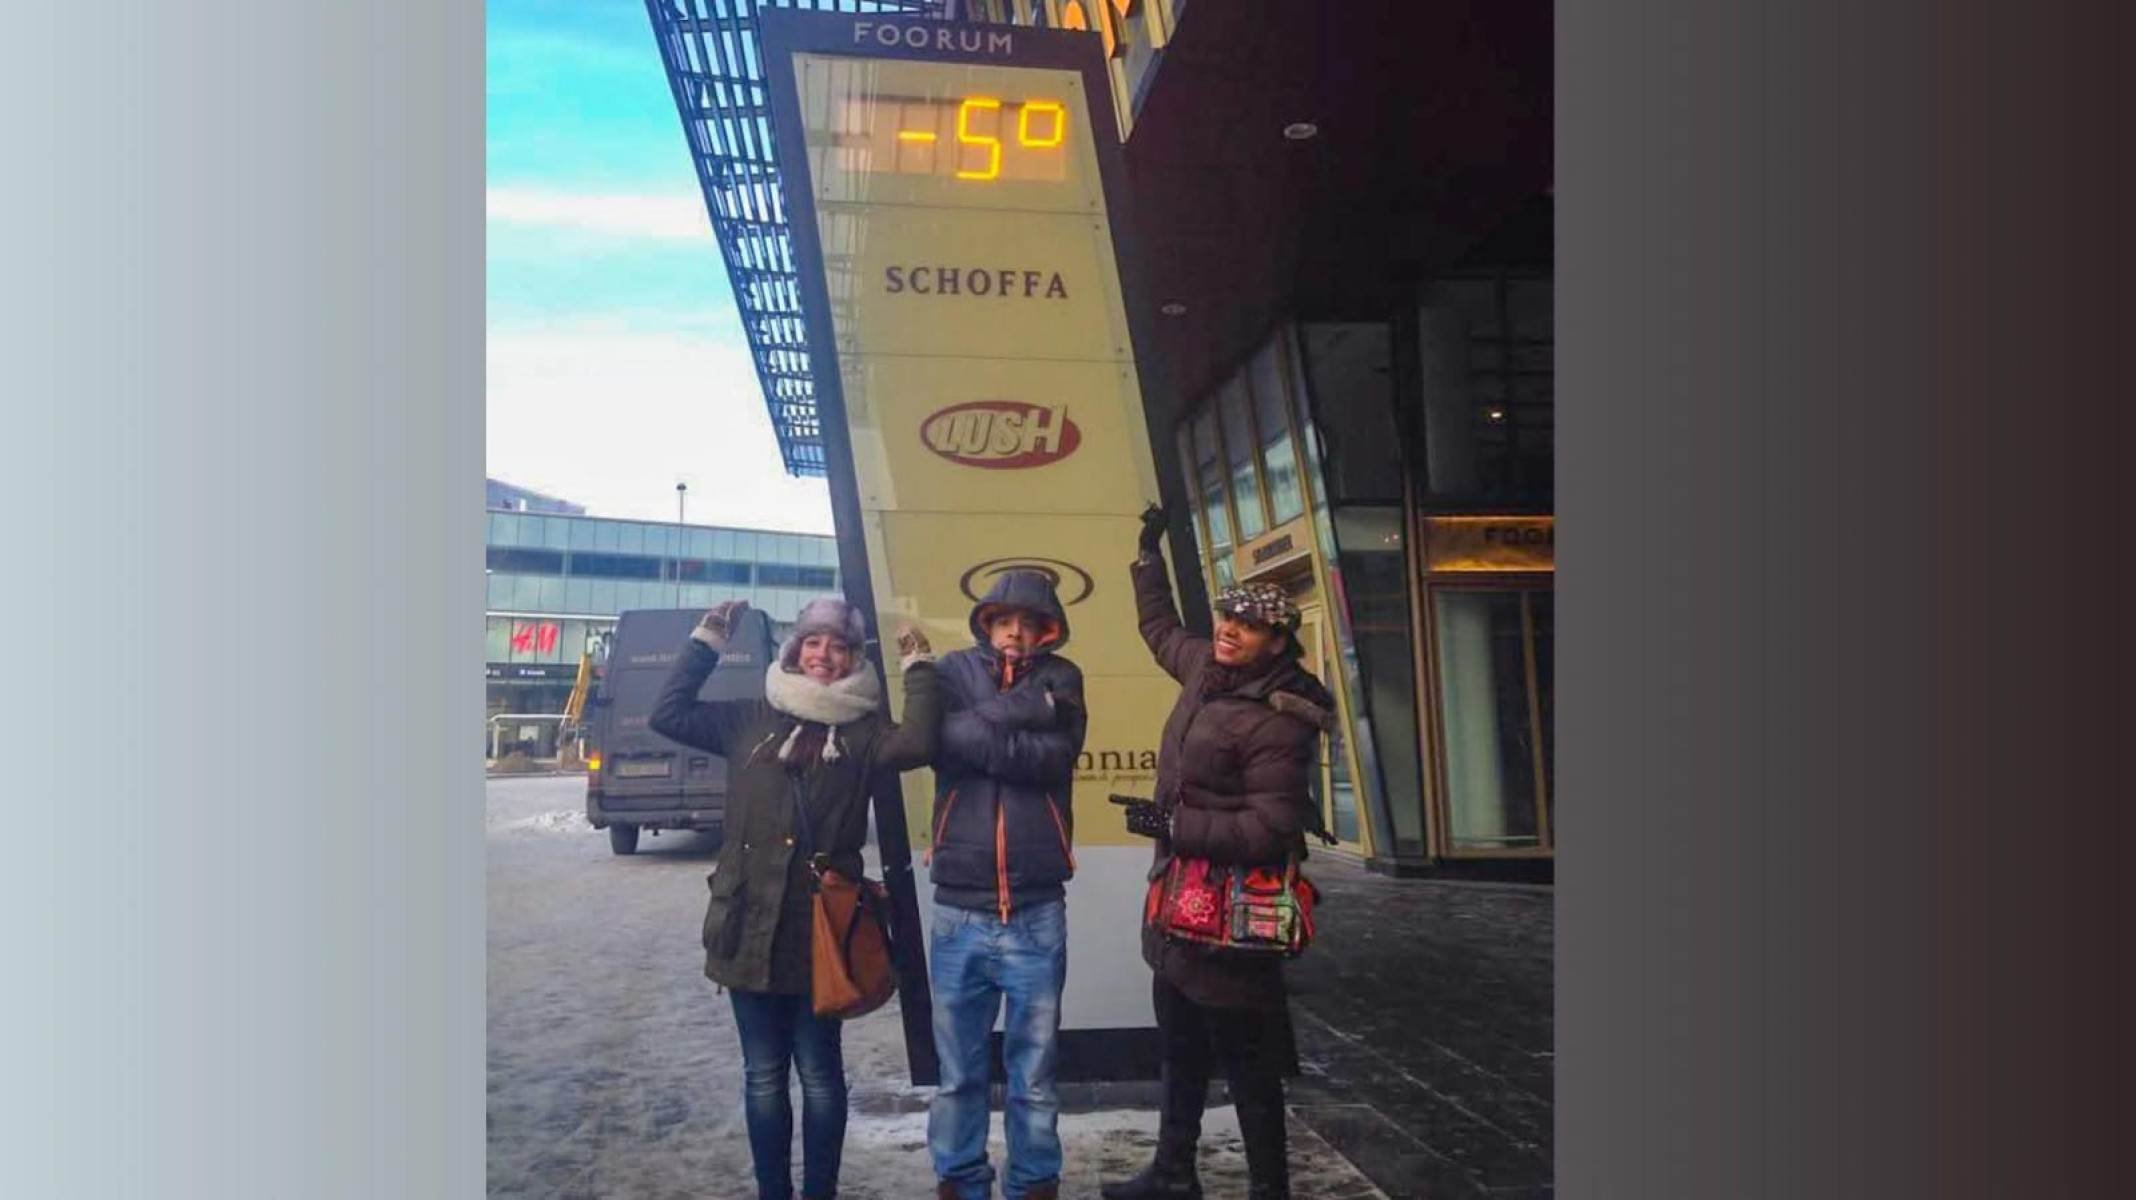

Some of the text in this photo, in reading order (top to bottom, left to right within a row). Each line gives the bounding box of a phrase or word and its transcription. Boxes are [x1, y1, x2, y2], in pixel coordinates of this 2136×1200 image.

[854, 21, 1013, 55] FOORUM
[886, 265, 1068, 299] SCHOFFA
[930, 404, 1068, 456] LUSH
